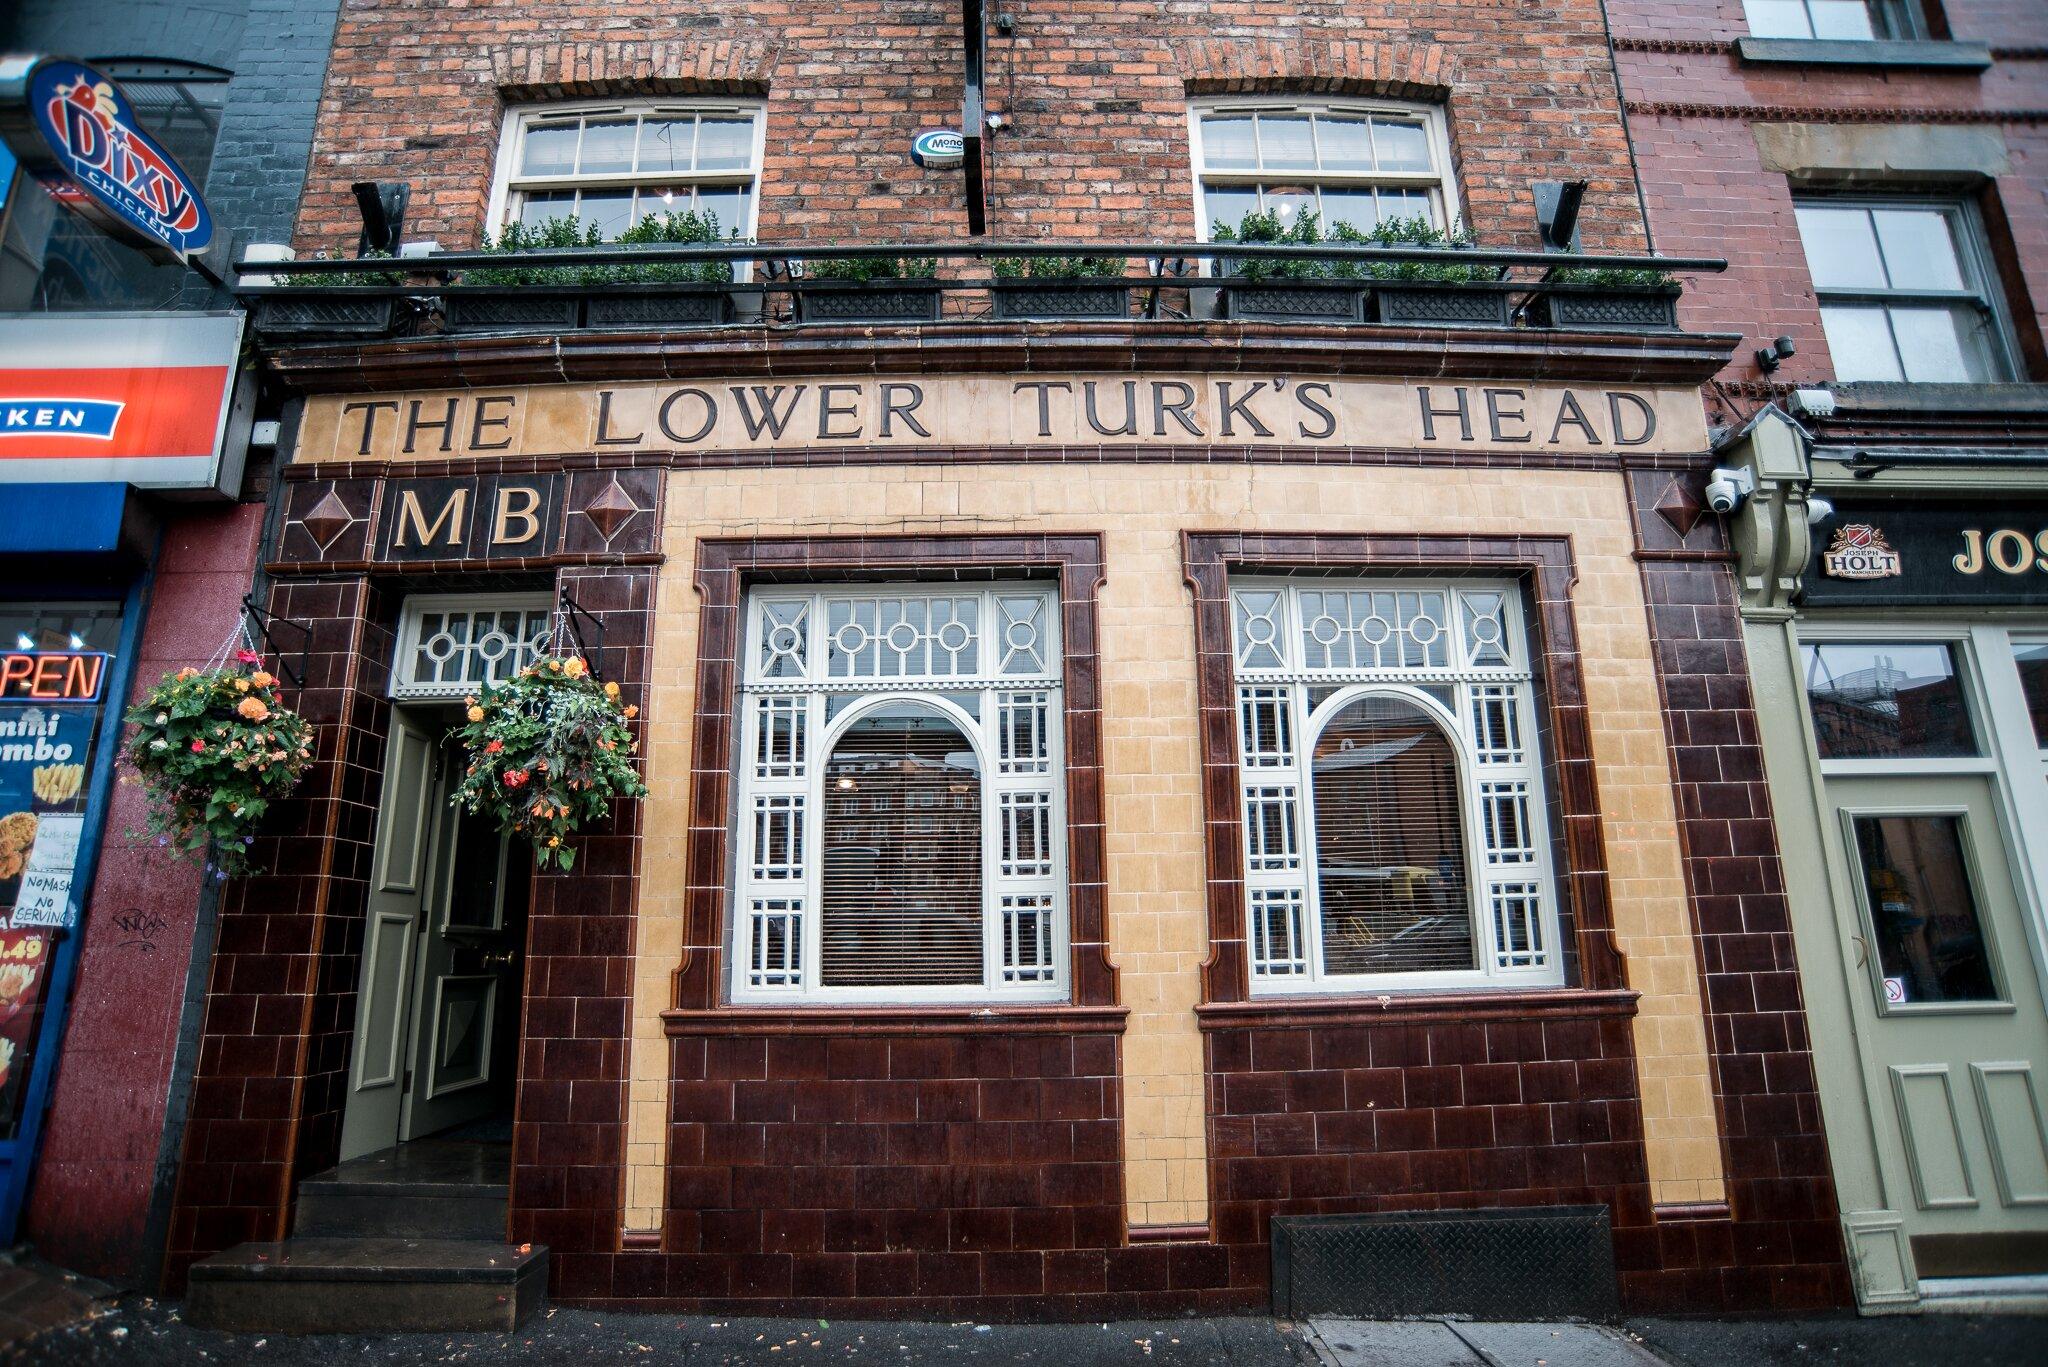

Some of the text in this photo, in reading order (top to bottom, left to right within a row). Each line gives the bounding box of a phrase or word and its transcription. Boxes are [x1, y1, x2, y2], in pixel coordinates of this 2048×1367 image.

[63, 97, 192, 228] DIXY
[88, 170, 171, 241] CHICKEN
[0, 408, 86, 427] KEN
[342, 377, 1657, 455] THE LOWER TURK'S HEAD
[1828, 556, 1895, 570] HOLT
[0, 737, 73, 760] mbo
[35, 896, 53, 908] NO
